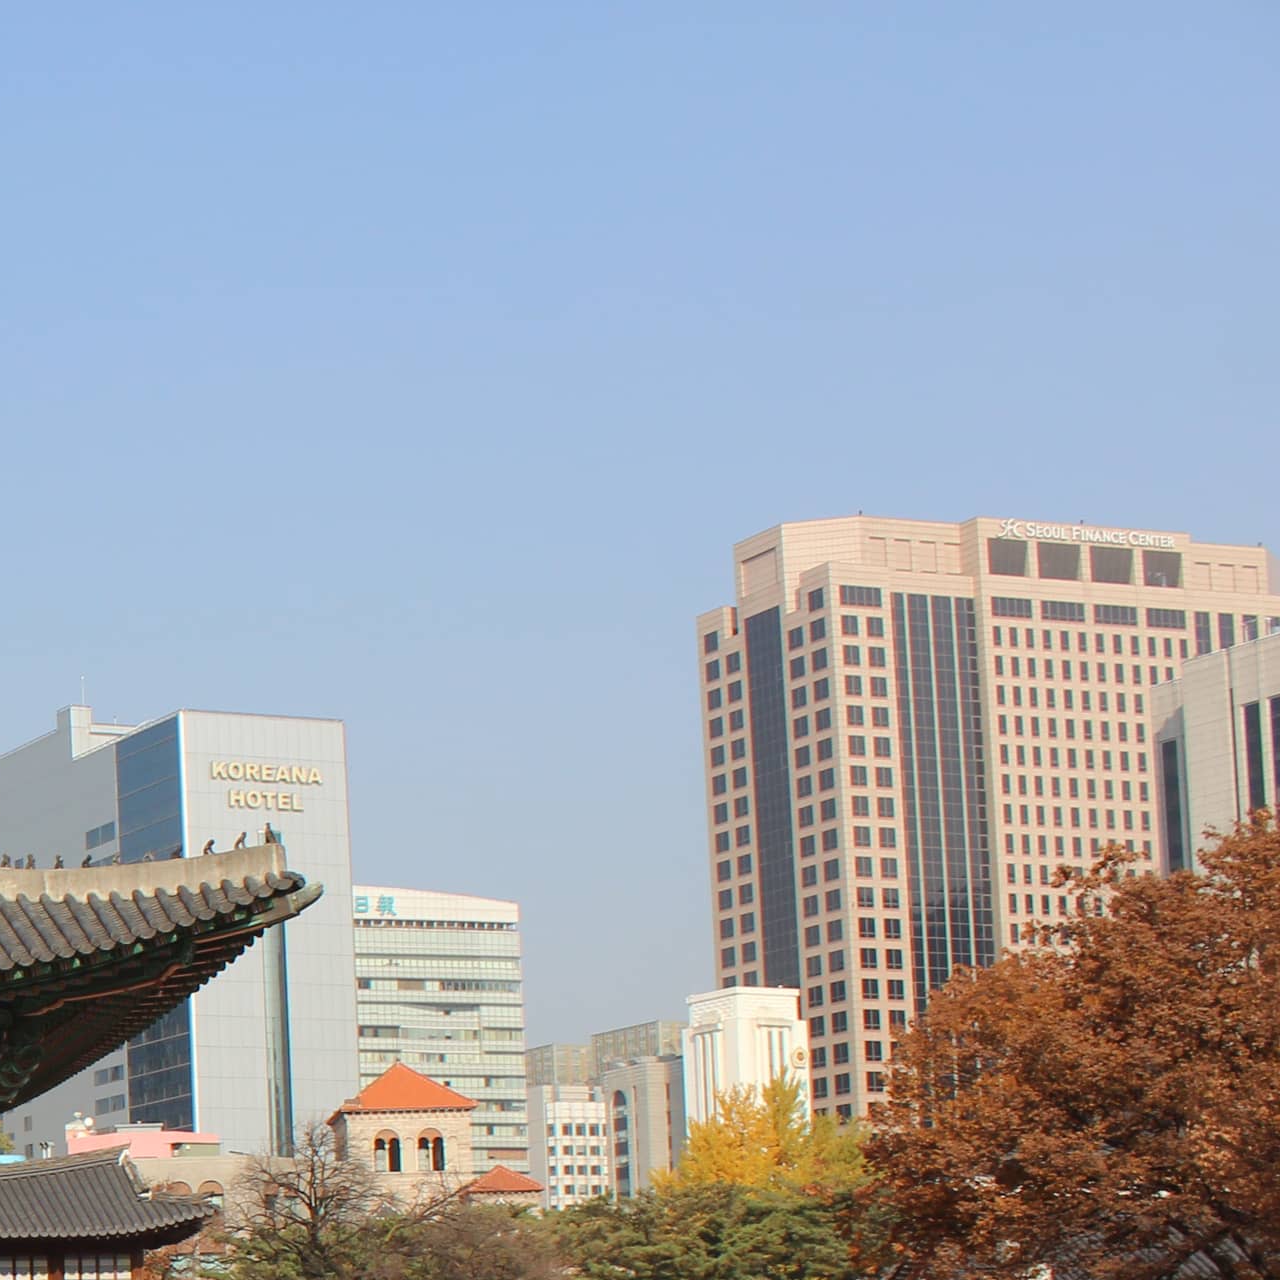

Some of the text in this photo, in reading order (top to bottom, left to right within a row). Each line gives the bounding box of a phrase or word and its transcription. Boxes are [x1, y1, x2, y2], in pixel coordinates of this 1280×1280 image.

[1026, 522, 1068, 540] SEOUL
[1072, 526, 1127, 545] FINANCE
[1128, 531, 1175, 548] CENTER
[211, 760, 323, 785] KOREANA
[228, 789, 305, 812] HOTEL
